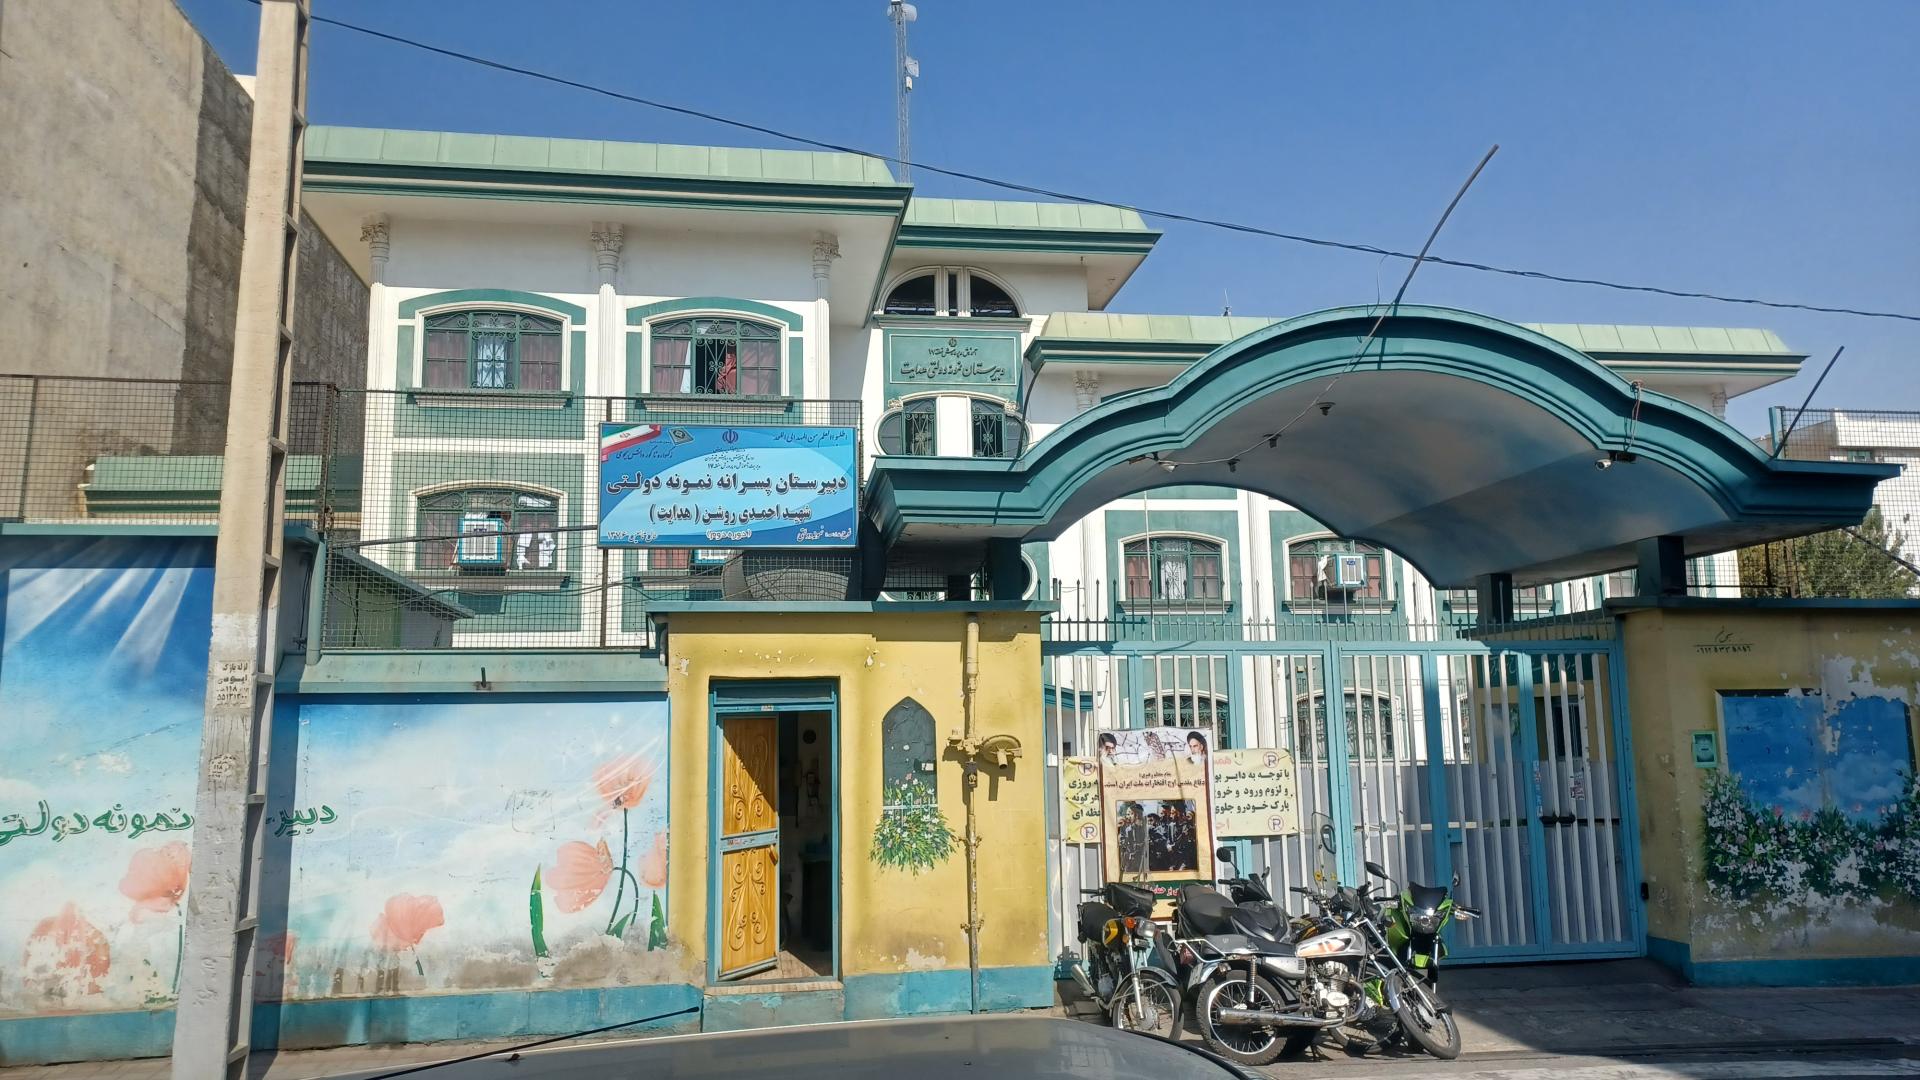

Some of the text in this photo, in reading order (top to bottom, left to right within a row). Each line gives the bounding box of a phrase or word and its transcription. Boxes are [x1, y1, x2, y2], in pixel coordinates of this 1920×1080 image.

[900, 360, 1005, 381] دبیرستان نمونه دولتی هدایت
[607, 472, 847, 496] دبیرستان پسرانه نمونه دولتی
[702, 506, 736, 526] روشن
[738, 504, 780, 523] احمدی
[782, 504, 812, 521] شهید
[1224, 771, 1247, 783] دایر
[1248, 772, 1256, 782] به
[1257, 769, 1283, 781] توجه
[1284, 769, 1290, 780] با
[1069, 779, 1092, 789] روزی
[1118, 780, 1133, 789] ایران
[1144, 779, 1167, 789] افتخارات
[1167, 780, 1177, 788] اوج
[1193, 778, 1206, 788] دفاع
[1215, 785, 1289, 798] و لزوم ورود و خرو
[1072, 793, 1089, 804] گونه
[1236, 800, 1269, 814] خودرو
[1270, 800, 1290, 812] پارک
[1072, 808, 1084, 820] ای
